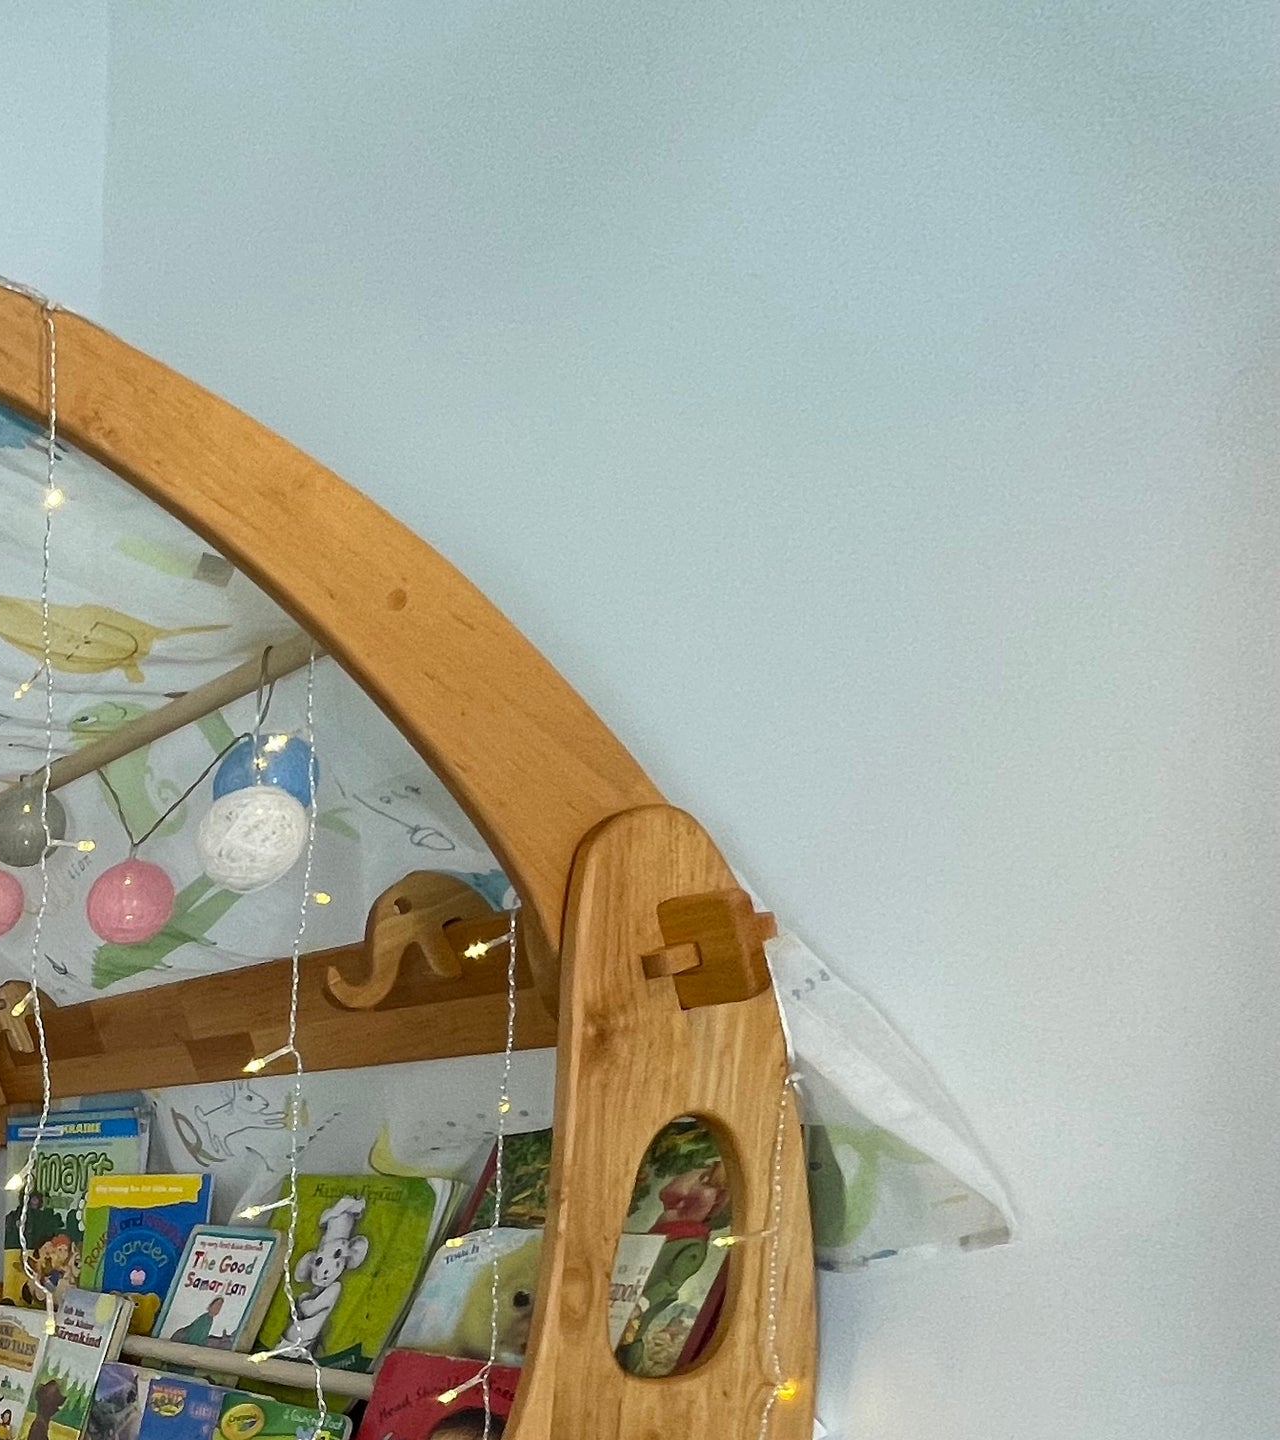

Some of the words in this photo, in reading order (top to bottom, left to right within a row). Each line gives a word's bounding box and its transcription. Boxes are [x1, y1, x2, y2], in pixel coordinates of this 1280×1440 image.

[113, 1238, 168, 1268] garden
[193, 1250, 216, 1271] The
[219, 1255, 258, 1275] Good
[184, 1271, 247, 1297] Samaritan
